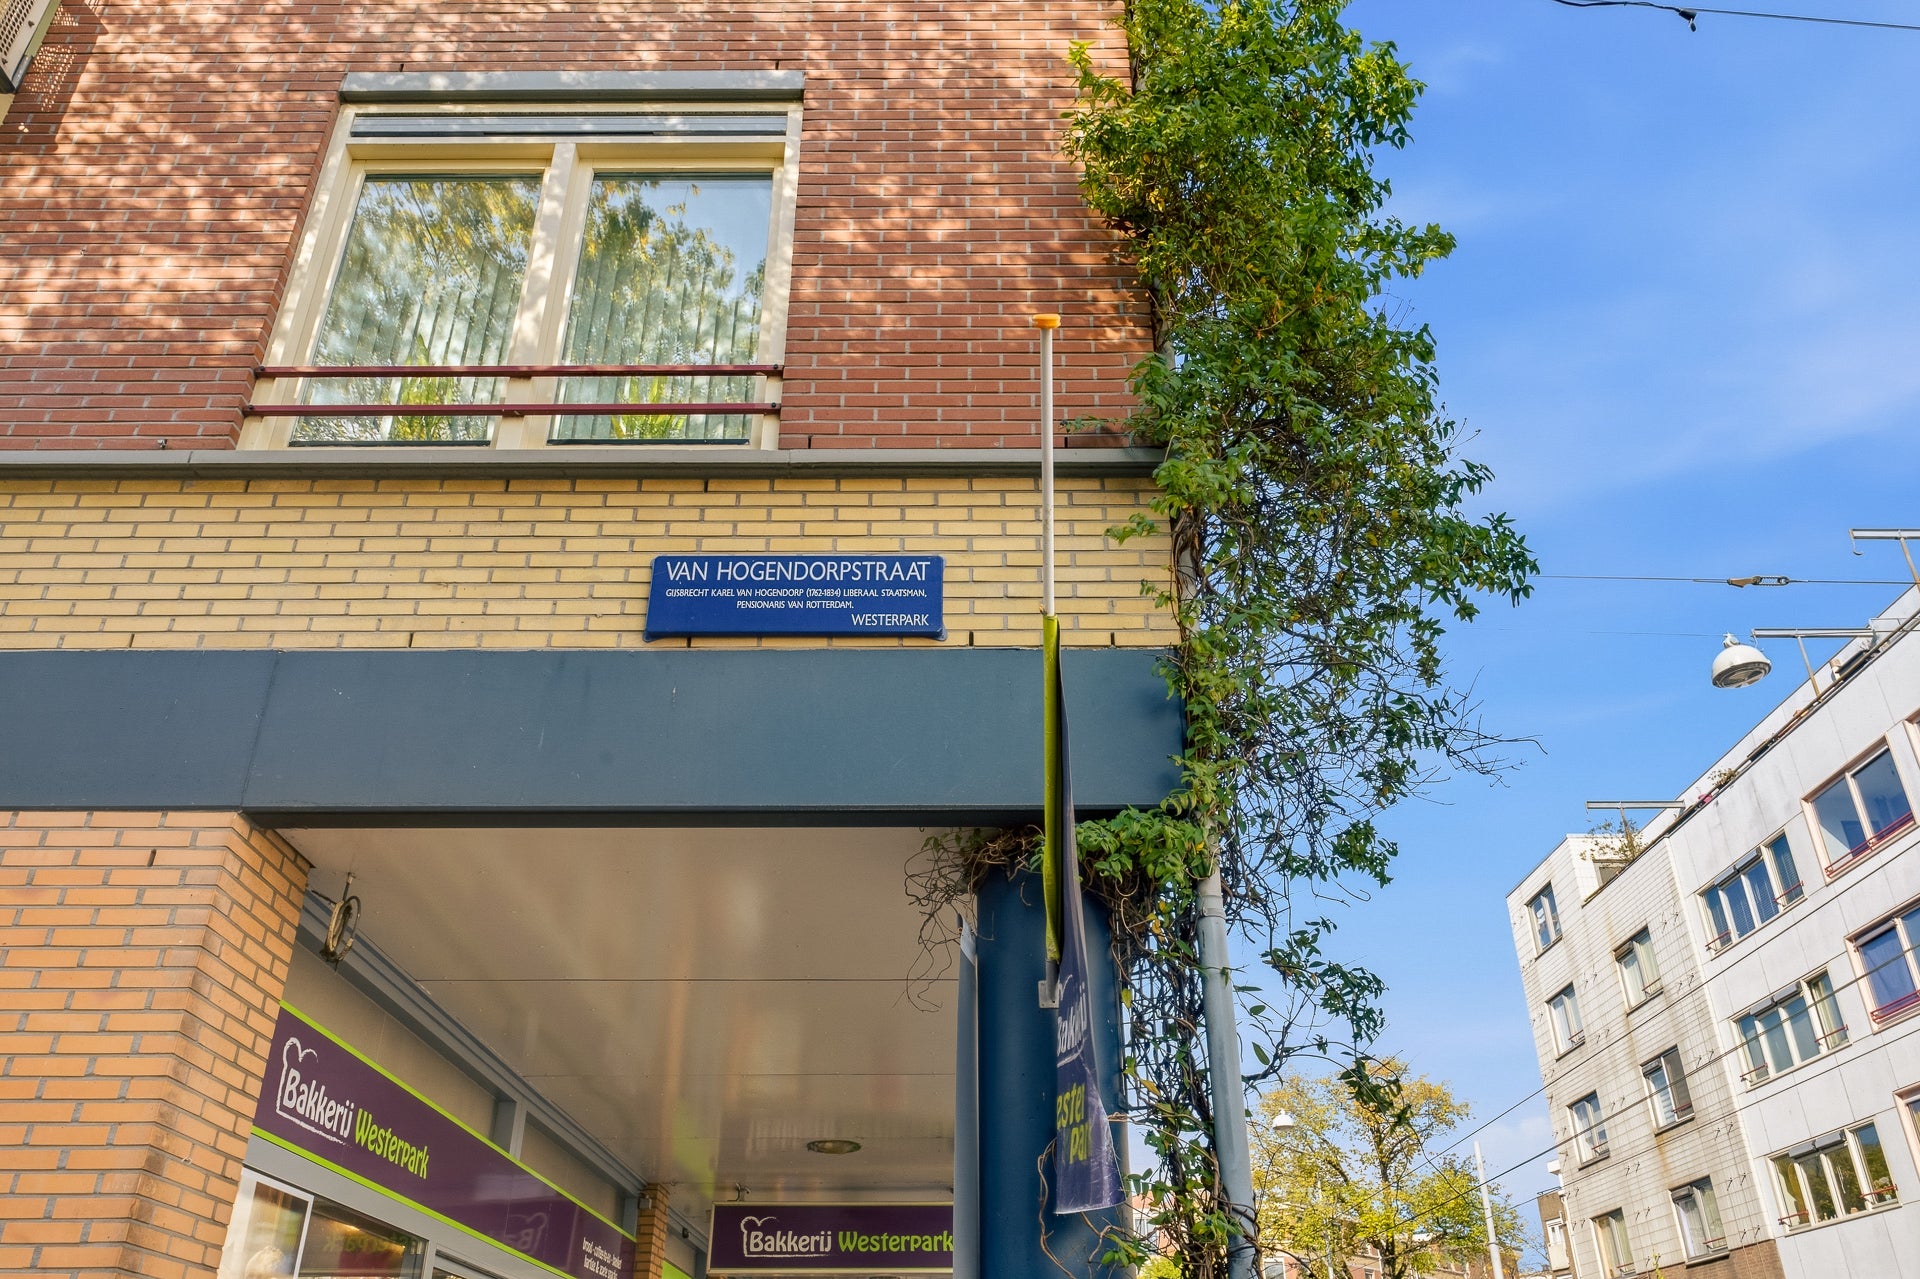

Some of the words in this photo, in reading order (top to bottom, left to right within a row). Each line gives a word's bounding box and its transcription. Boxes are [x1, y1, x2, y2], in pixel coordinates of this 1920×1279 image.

[666, 561, 708, 581] VAN
[717, 561, 930, 581] HOGENDORPSTRAAT
[665, 588, 709, 597] GIJSBRECHT
[711, 588, 735, 597] KAREL
[736, 588, 752, 597] VAN
[754, 588, 804, 597] HOGENDORP
[806, 588, 841, 597] (1762-1834)
[843, 588, 879, 597] LIBERAAL
[881, 588, 927, 598] STAATSMAN,
[736, 600, 785, 609] PENSIONARIS
[787, 600, 804, 609] VAN
[806, 600, 855, 609] ROTTERDAM.
[851, 613, 929, 626] WESTERPARK
[283, 1068, 354, 1138] Bakkerij
[355, 1108, 429, 1179] Westerpark
[750, 1230, 832, 1252] Bakkerij
[838, 1230, 954, 1252] Westerpark
